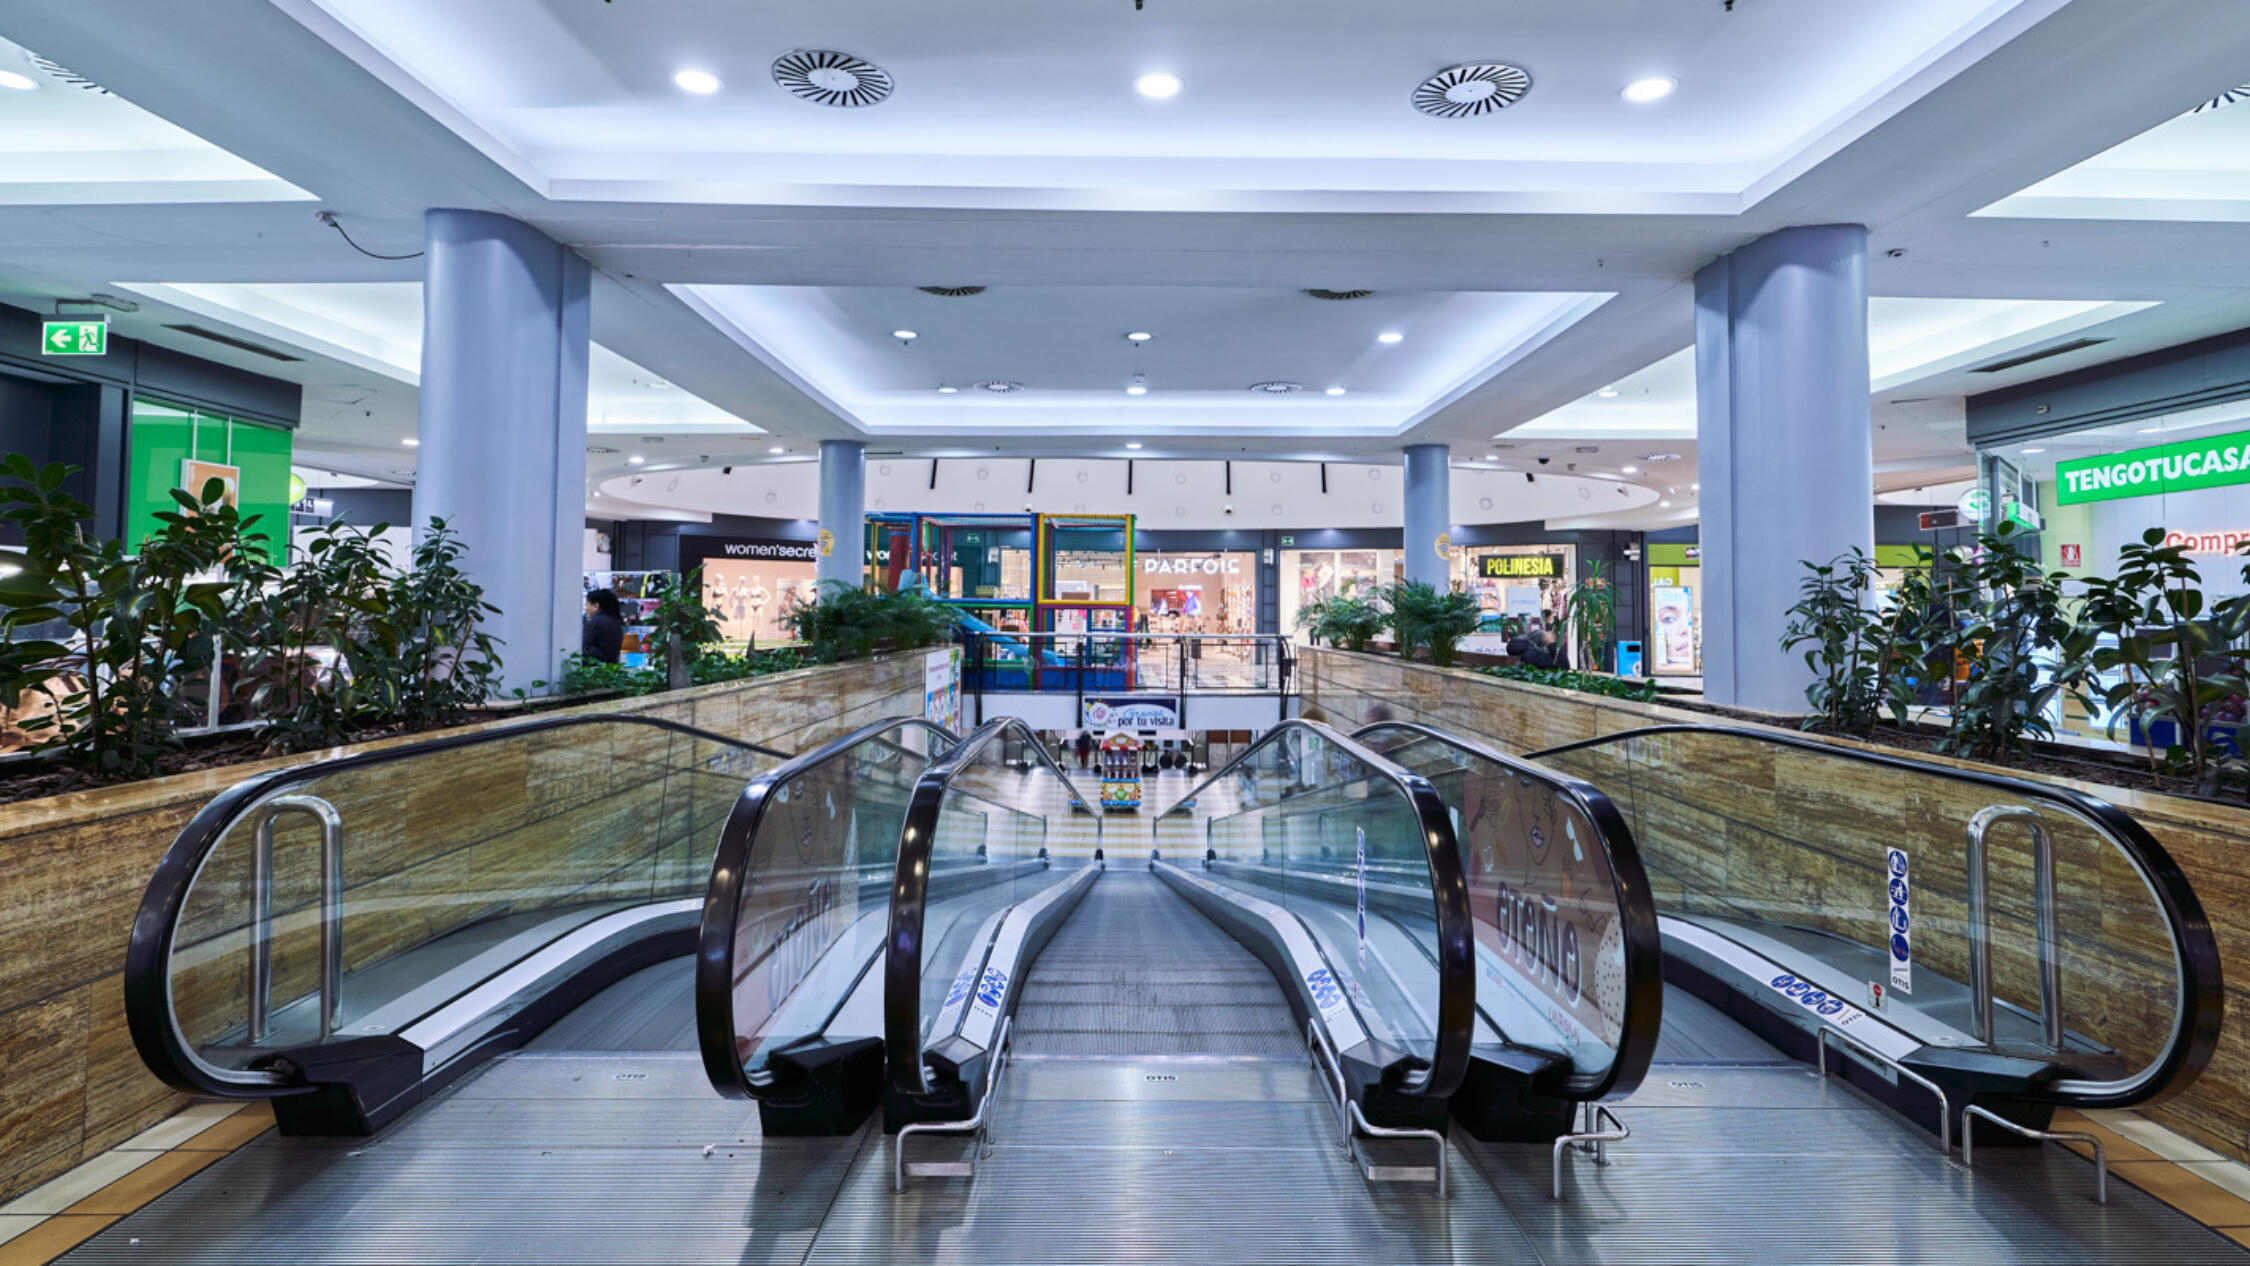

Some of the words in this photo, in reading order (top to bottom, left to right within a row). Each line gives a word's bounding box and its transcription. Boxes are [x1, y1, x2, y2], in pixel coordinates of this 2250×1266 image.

[725, 543, 817, 558] women'secre
[1486, 557, 1554, 575] POLINESIA
[1118, 719, 1132, 727] por
[1137, 718, 1147, 727] tu
[1150, 717, 1174, 727] visita
[1892, 975, 1909, 990] OTIS
